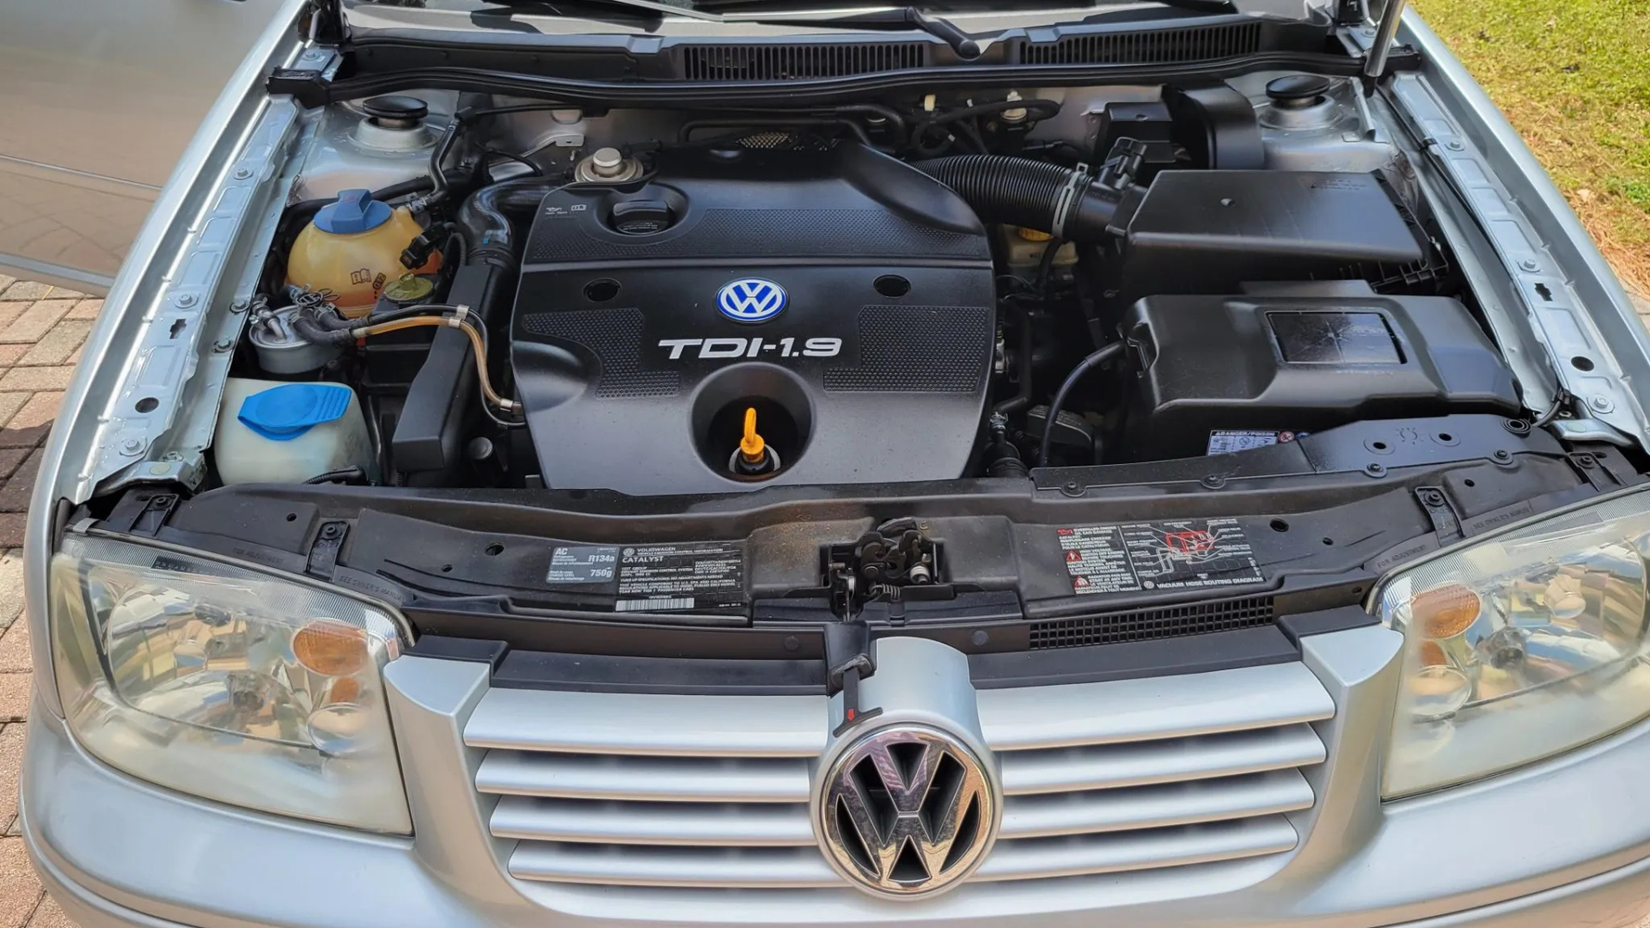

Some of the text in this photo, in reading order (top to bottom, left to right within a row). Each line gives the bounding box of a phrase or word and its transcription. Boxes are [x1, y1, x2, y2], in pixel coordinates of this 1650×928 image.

[717, 278, 786, 321] VW
[658, 338, 842, 360] TDI-1.9
[590, 569, 612, 578] 750g
[822, 726, 994, 893] VW
